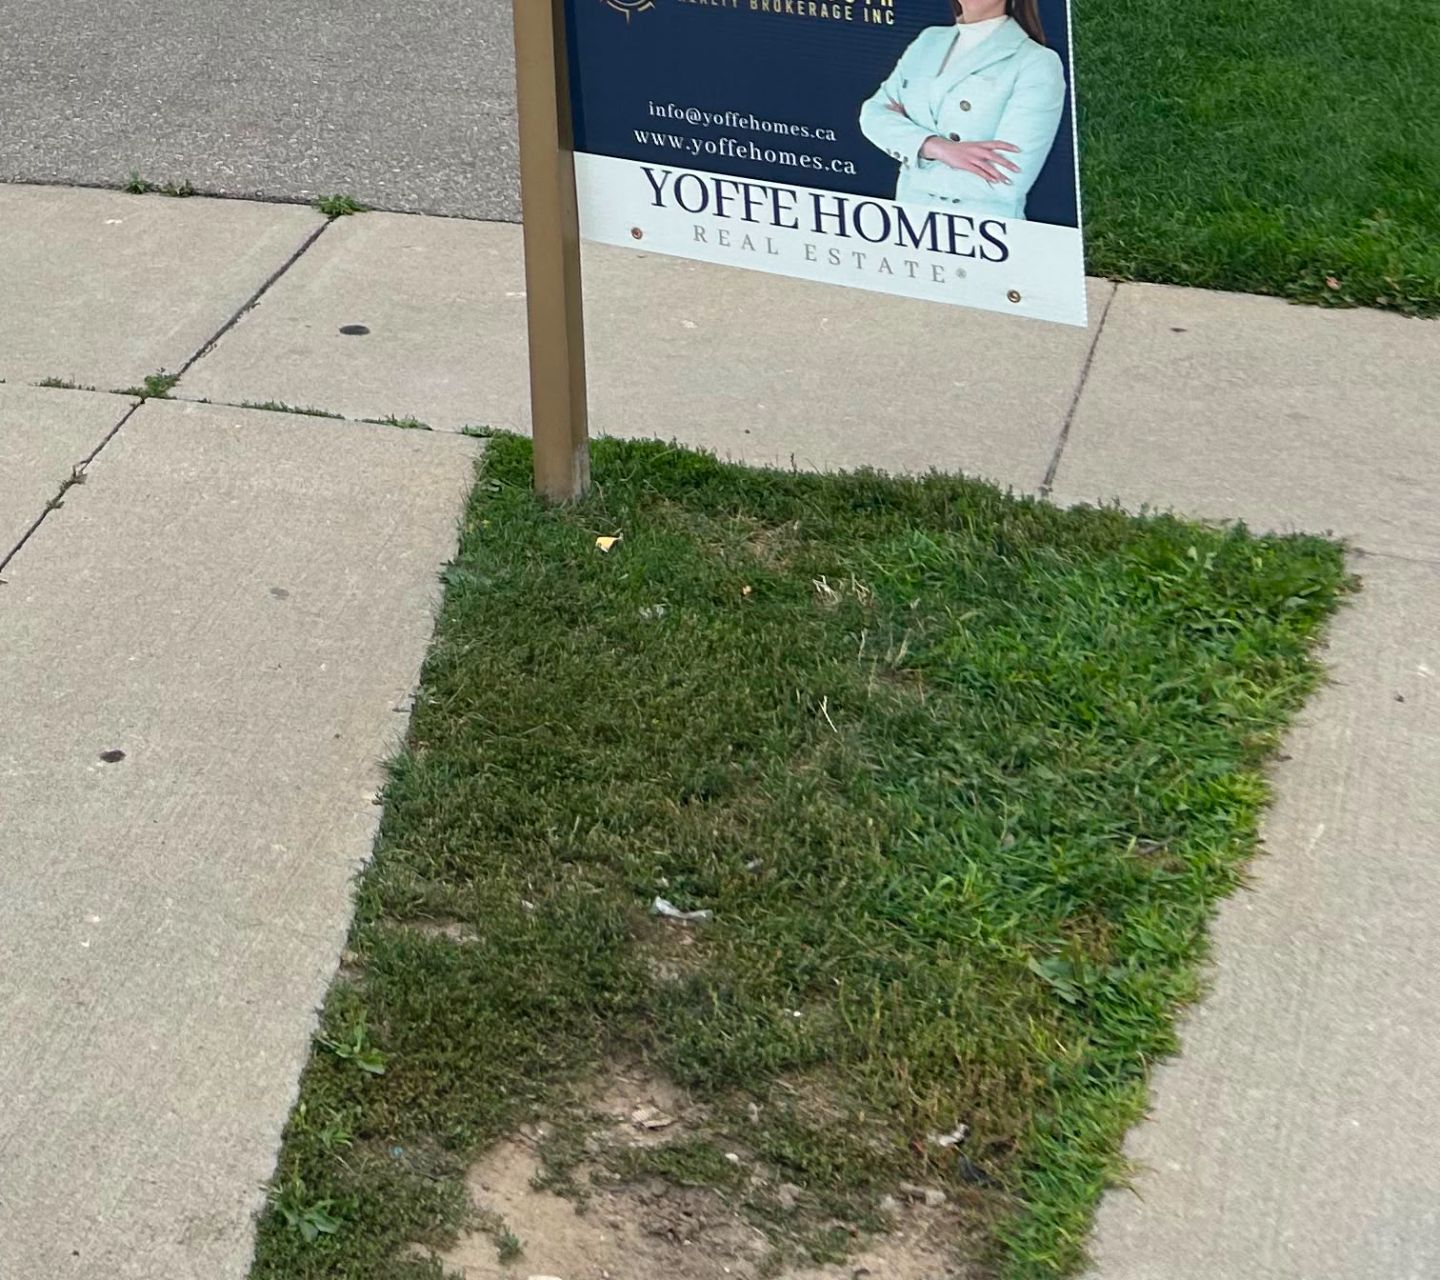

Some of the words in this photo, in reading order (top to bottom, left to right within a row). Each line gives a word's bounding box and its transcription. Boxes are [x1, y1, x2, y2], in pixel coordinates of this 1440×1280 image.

[863, 7, 895, 26] INC
[648, 100, 837, 142] info@yoffehomes.ca
[633, 129, 857, 175] www.yoffehomes.ca
[639, 165, 800, 230] YOFFE
[808, 192, 1010, 264] HOMES
[693, 223, 780, 257] REAL
